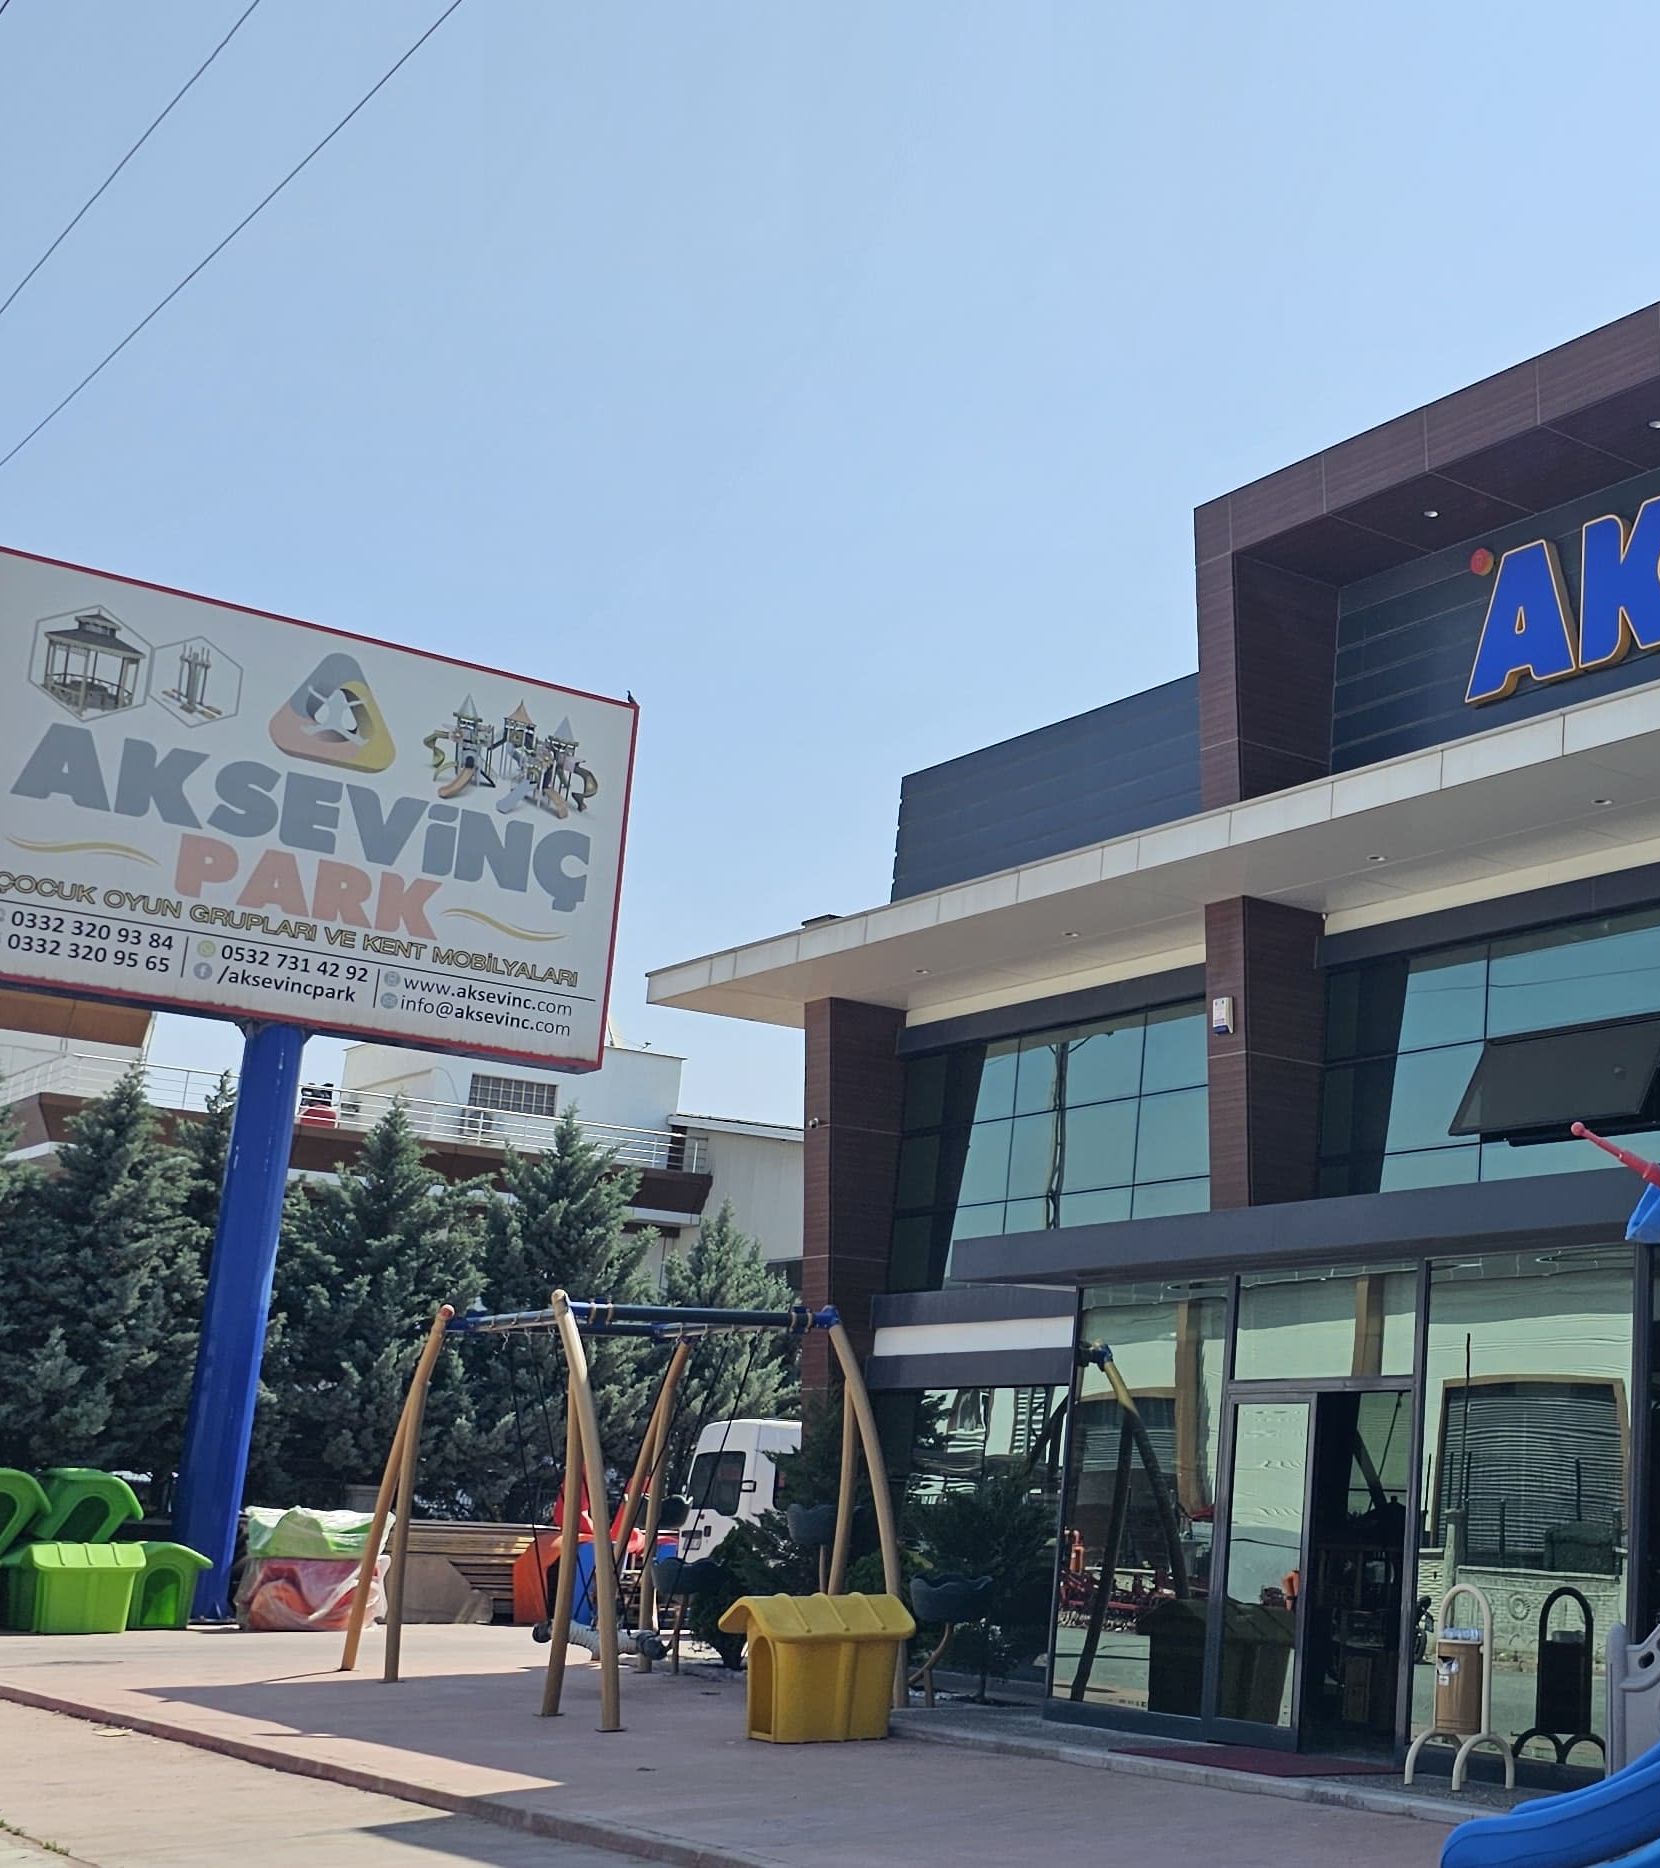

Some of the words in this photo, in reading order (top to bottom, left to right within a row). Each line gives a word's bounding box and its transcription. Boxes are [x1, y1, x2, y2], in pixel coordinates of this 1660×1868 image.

[174, 833, 444, 941] PARK
[0, 871, 97, 904] ÇOCUK
[103, 889, 182, 919] OYUN
[189, 904, 317, 941] GRUPLARI
[324, 926, 357, 949] VE
[362, 934, 427, 961] KENT
[11, 910, 65, 933] 0332
[71, 920, 111, 940] 320
[117, 927, 142, 945] 93
[149, 933, 173, 950] 84
[8, 933, 61, 956] 0332
[67, 943, 107, 963] 320
[113, 950, 138, 968] 95
[145, 956, 170, 973] 65
[221, 944, 269, 966] 0532
[276, 953, 311, 973] 731
[317, 961, 340, 978] 42
[346, 966, 368, 982] 92
[217, 965, 356, 1002] /aksevincpark
[403, 977, 572, 1016] www.aksevinc.com
[400, 995, 570, 1036] info@aksevinc.com
